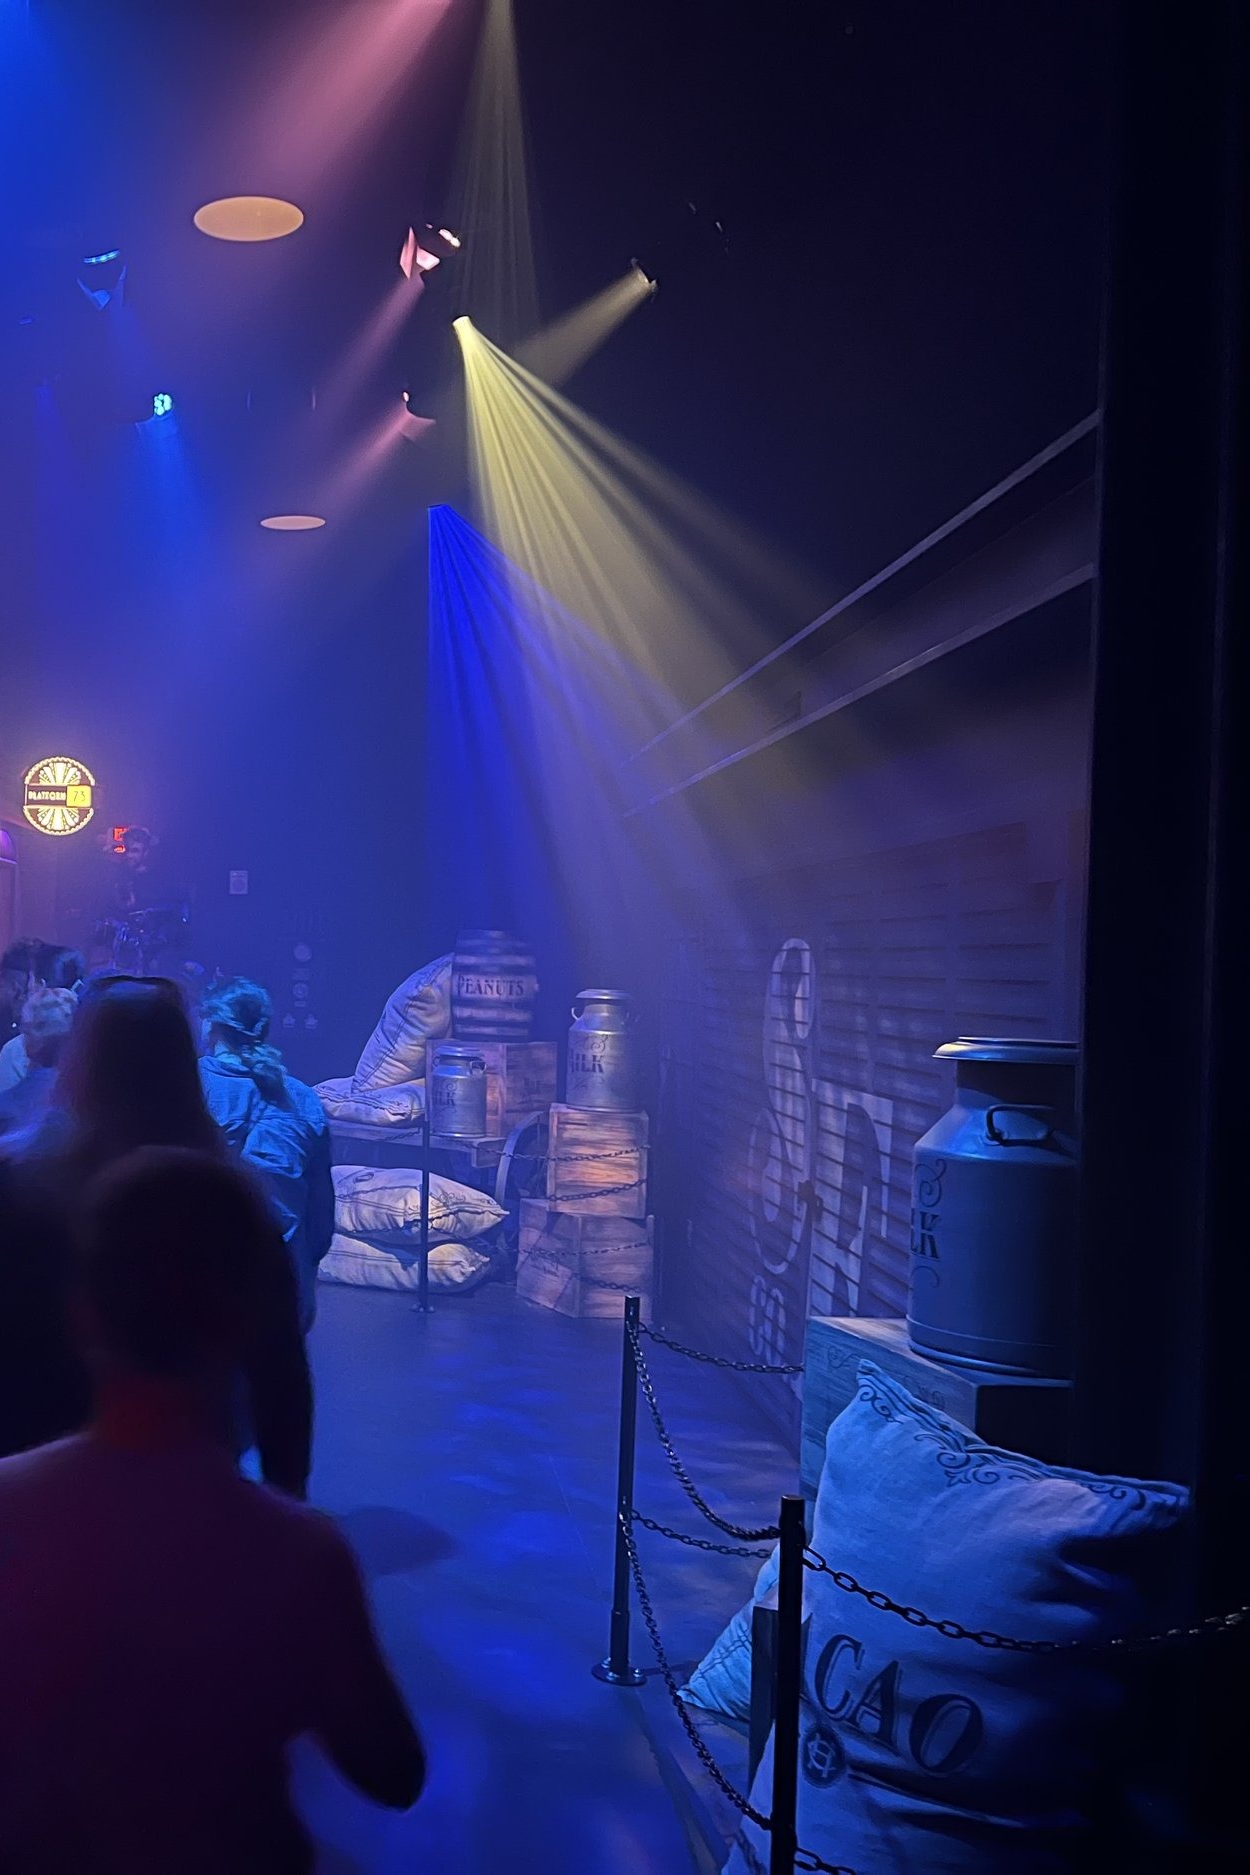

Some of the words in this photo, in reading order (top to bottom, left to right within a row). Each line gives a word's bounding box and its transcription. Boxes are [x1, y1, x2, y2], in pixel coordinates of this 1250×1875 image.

[28, 791, 66, 800] PLATFORM
[73, 791, 85, 802] 73
[457, 974, 525, 996] PEANUTS
